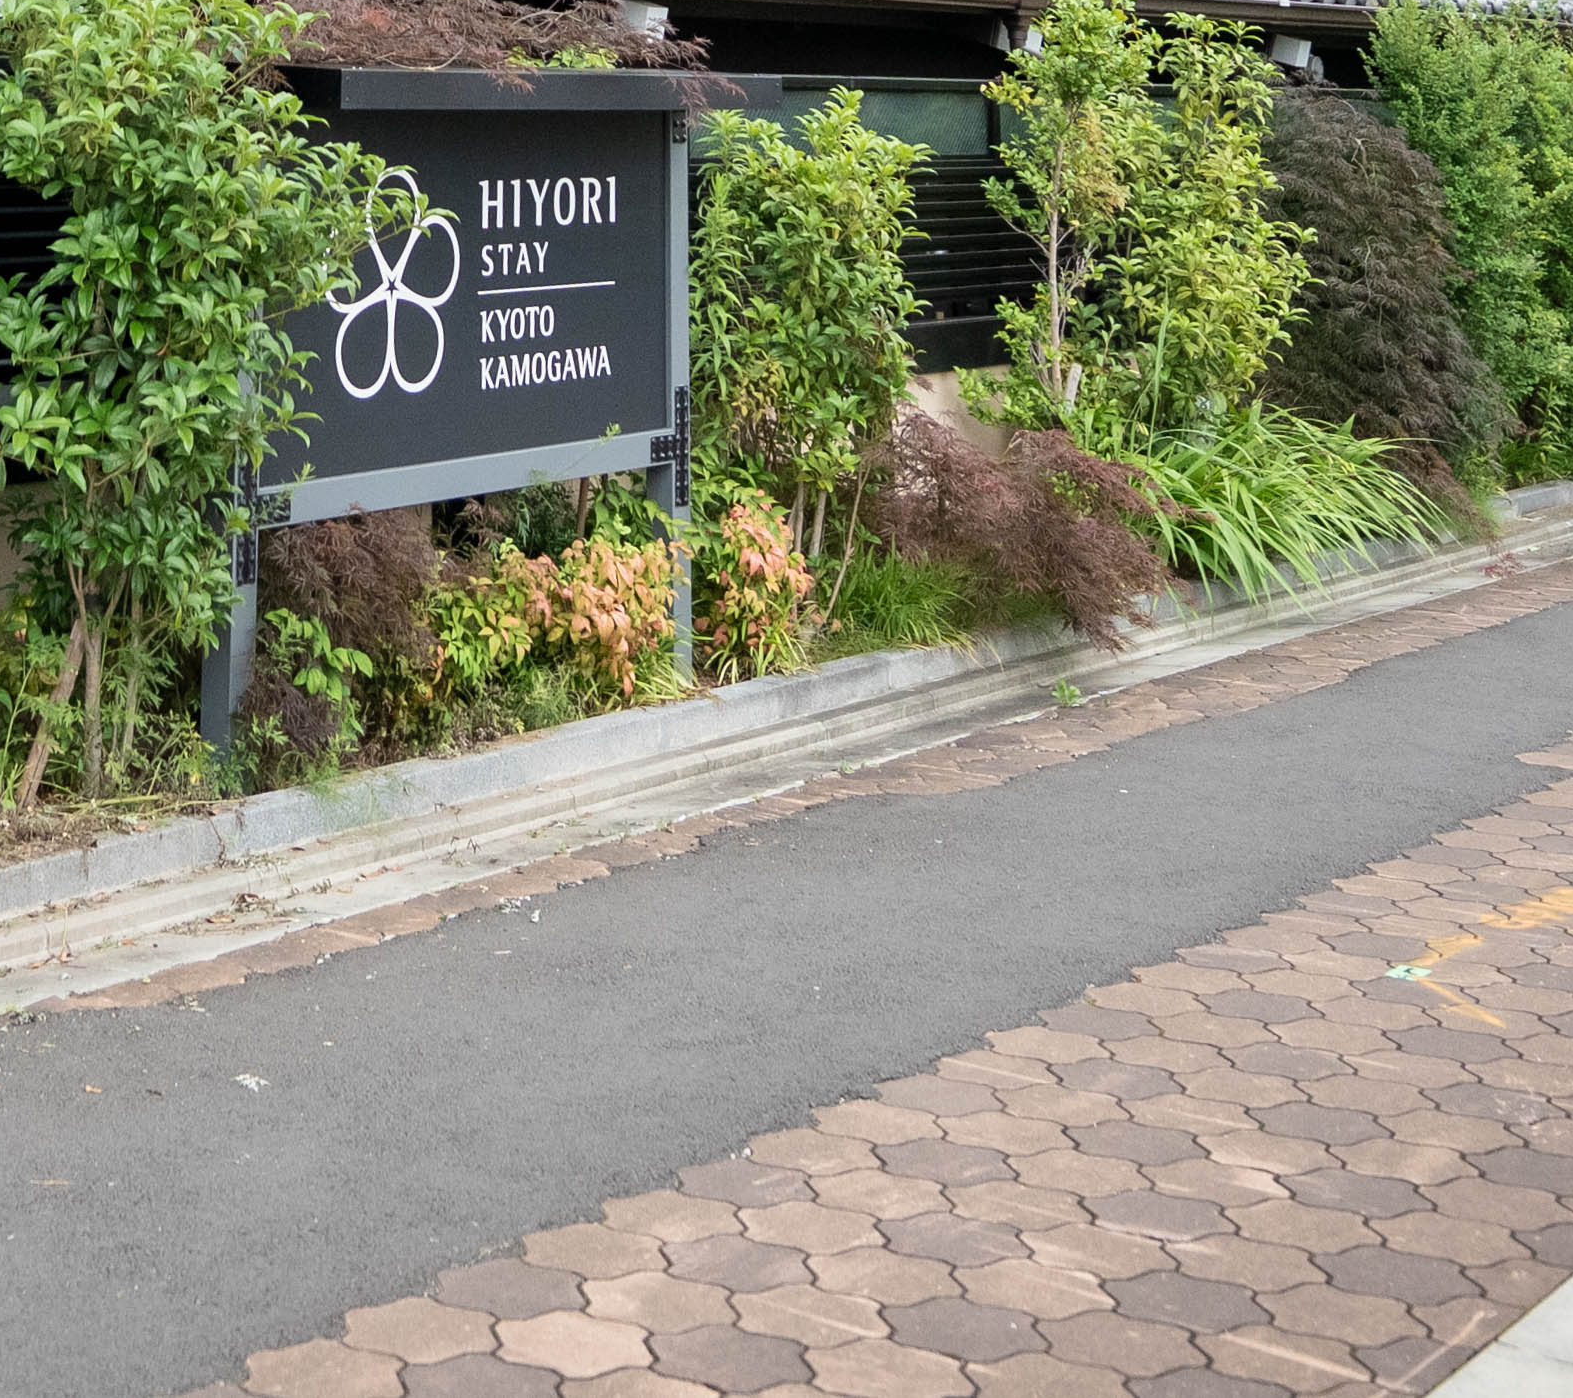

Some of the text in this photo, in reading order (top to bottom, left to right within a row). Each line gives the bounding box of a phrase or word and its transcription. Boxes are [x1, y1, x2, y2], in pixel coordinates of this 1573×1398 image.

[478, 175, 617, 229] HIYORI
[480, 241, 549, 277] STAY
[479, 305, 556, 344] KYOTO
[479, 345, 612, 391] KAMOGAWA
